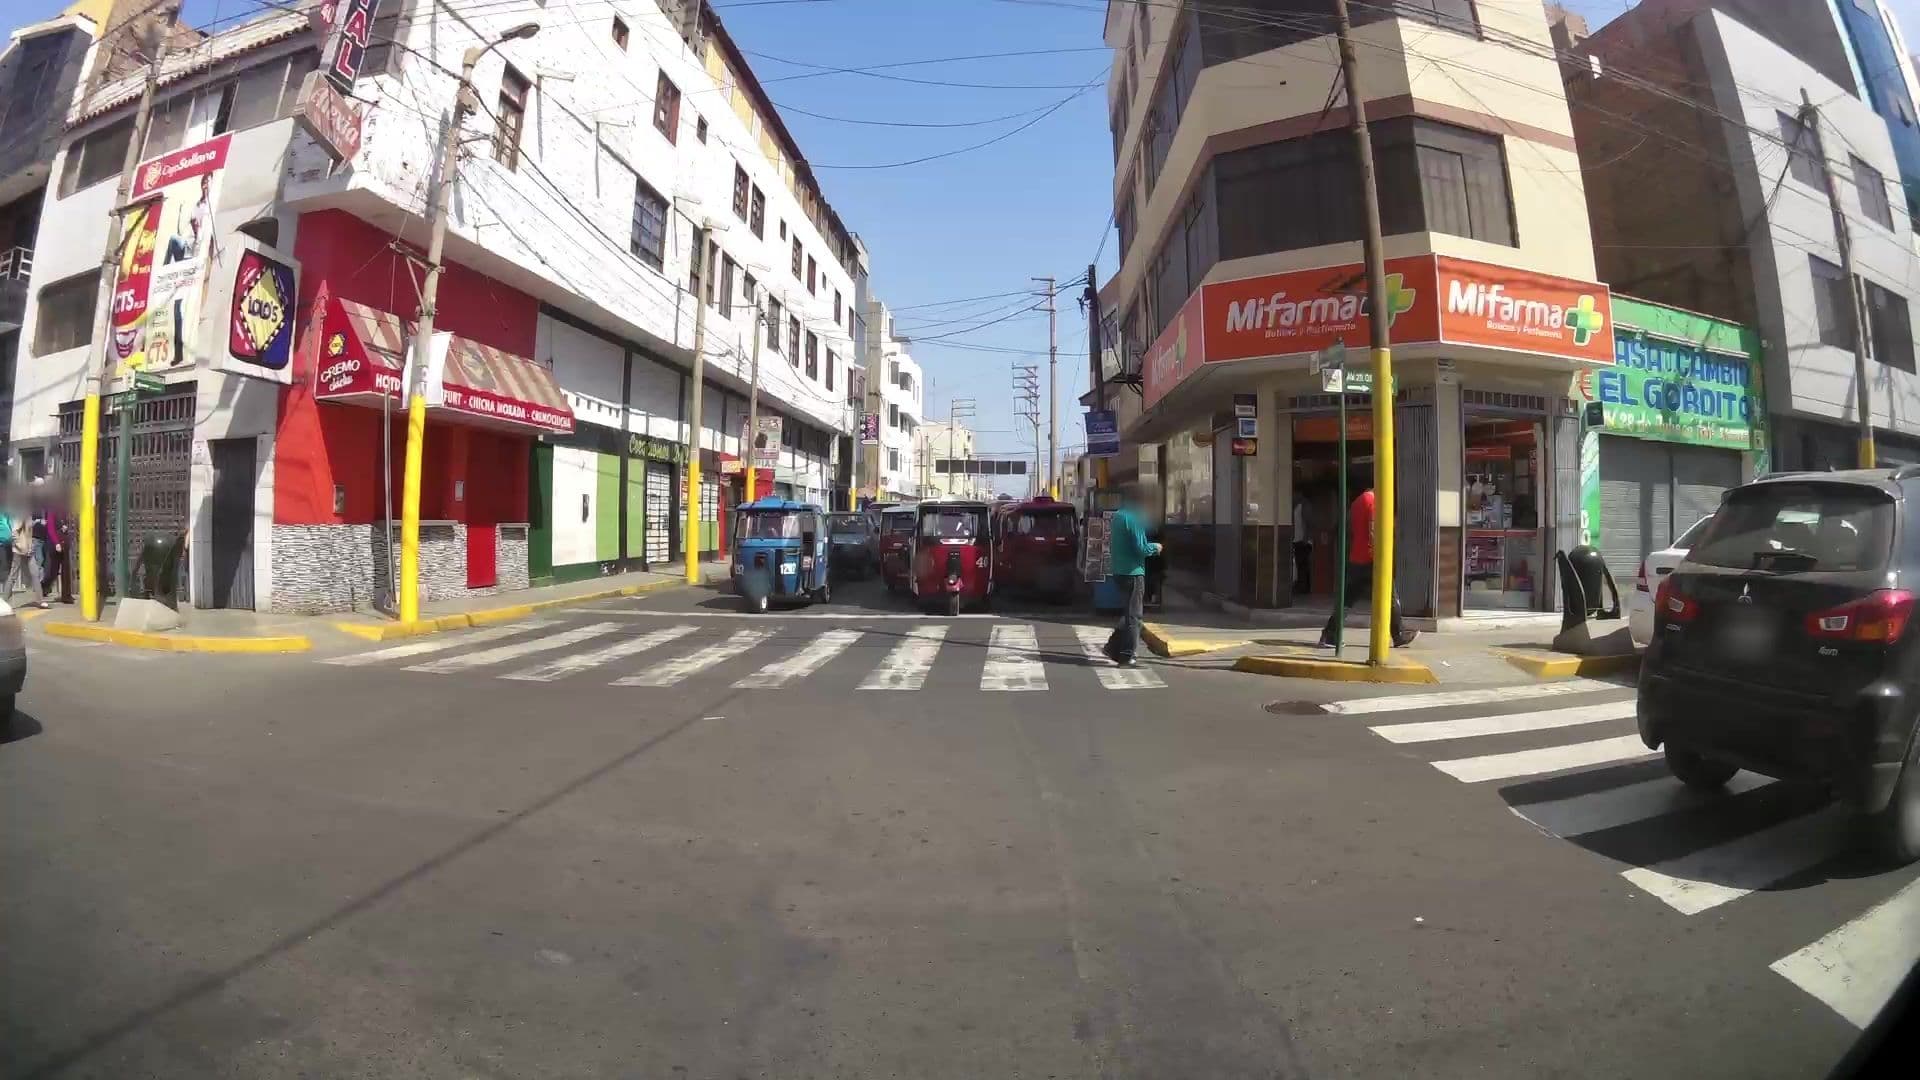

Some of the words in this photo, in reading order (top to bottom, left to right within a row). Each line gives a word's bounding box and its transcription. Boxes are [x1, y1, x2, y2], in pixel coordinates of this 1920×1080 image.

[336, 0, 370, 82] AL
[1226, 292, 1357, 332] Mifarma
[1448, 280, 1563, 328] Mifarma
[320, 359, 361, 383] CREMO
[1616, 334, 1661, 372] ASA
[375, 373, 401, 392] HOTD
[1600, 371, 1638, 405] EL
[1643, 376, 1752, 422] GORDITO
